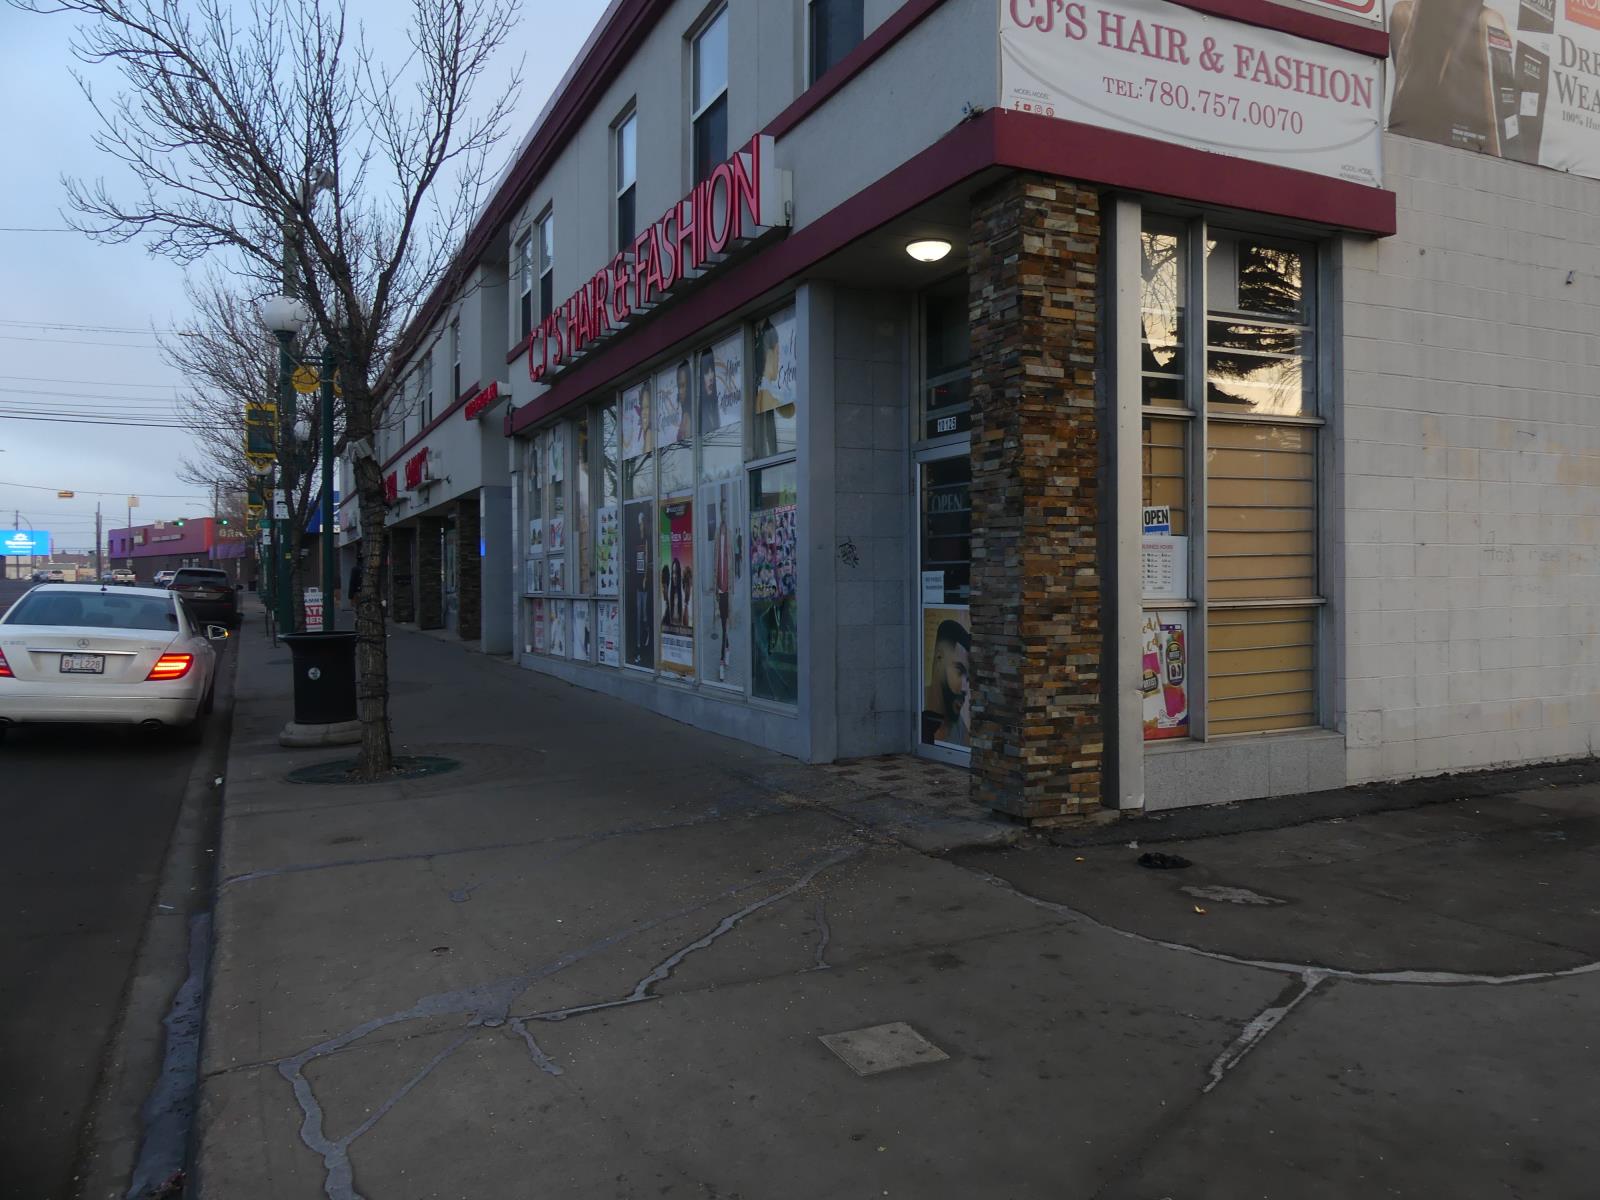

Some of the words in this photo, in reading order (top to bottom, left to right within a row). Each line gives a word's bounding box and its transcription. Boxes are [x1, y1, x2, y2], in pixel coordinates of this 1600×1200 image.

[1009, 0, 1087, 41] CJ'S
[1097, 10, 1190, 66] HAIR
[1199, 36, 1225, 74] &
[1233, 43, 1374, 110] FASHION
[528, 305, 562, 383] CJ'S
[566, 268, 611, 357] HAIR
[612, 251, 631, 322] &
[634, 133, 761, 309] FASHION
[1144, 509, 1169, 526] OPEN
